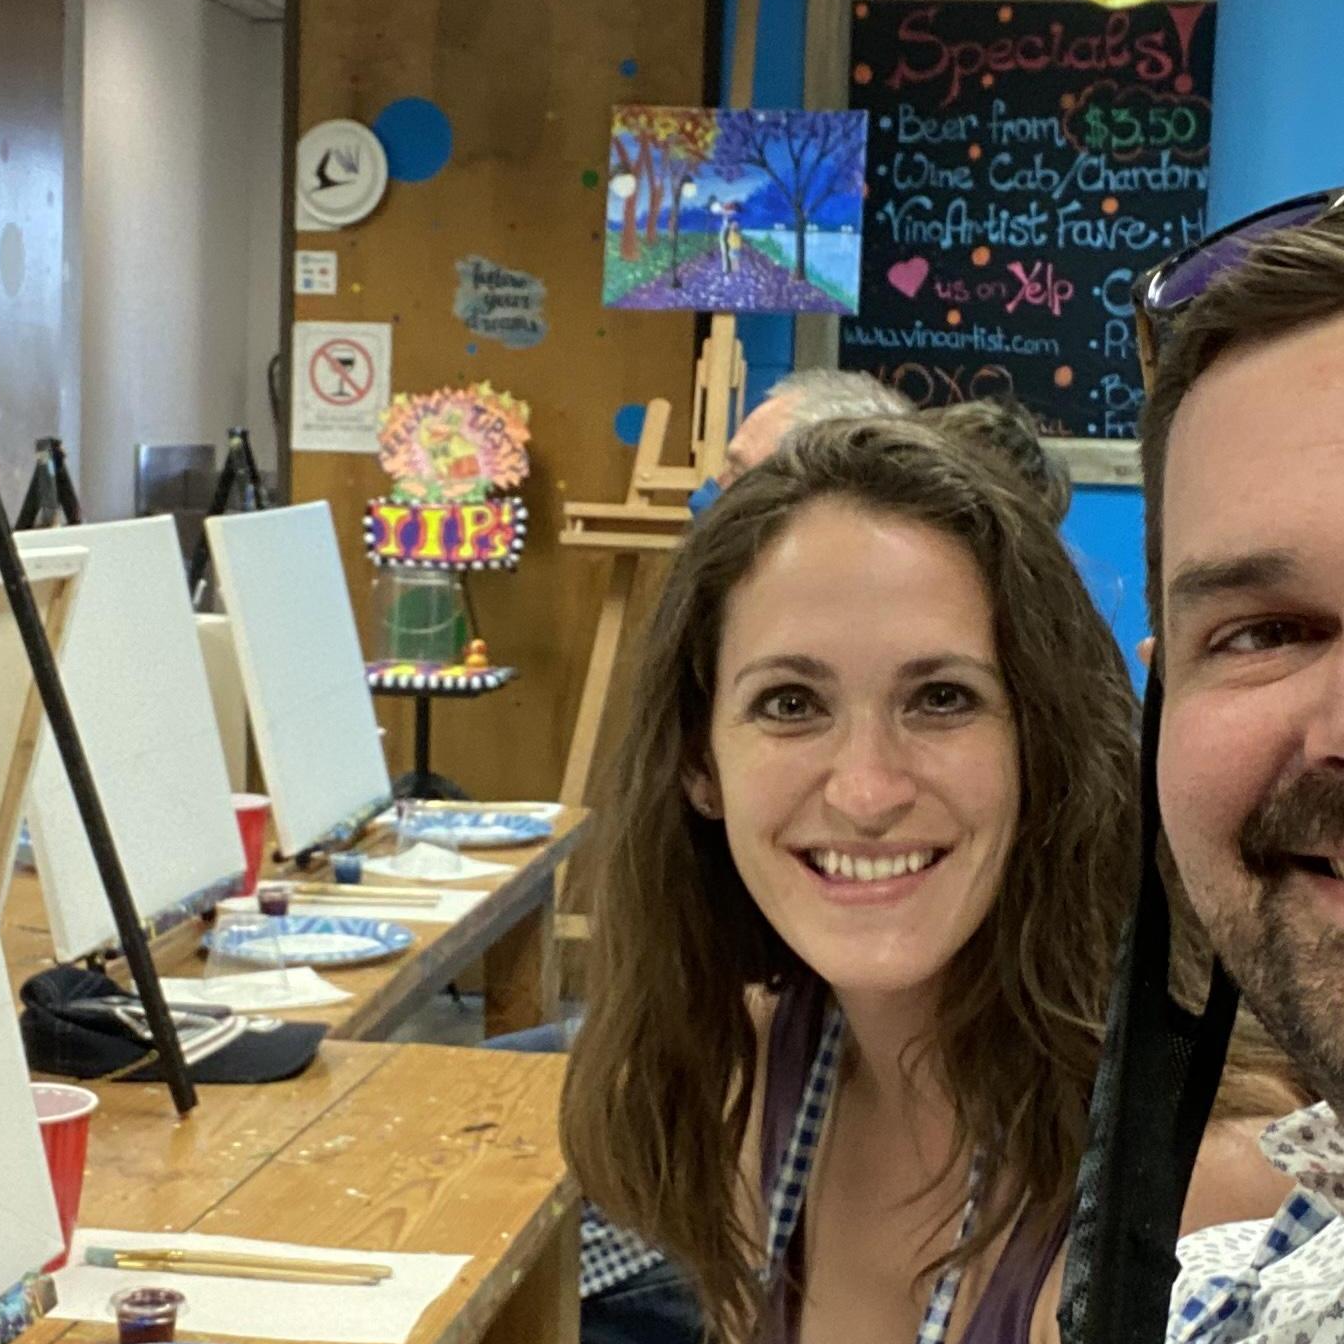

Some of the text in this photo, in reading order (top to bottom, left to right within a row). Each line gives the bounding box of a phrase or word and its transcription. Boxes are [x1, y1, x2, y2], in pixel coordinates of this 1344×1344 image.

[887, 5, 1207, 106] Specials!
[898, 98, 1197, 150] Beer from $3.50
[892, 151, 975, 191] Wine
[934, 260, 1074, 316] us on Yelp
[878, 361, 1014, 408] OXO
